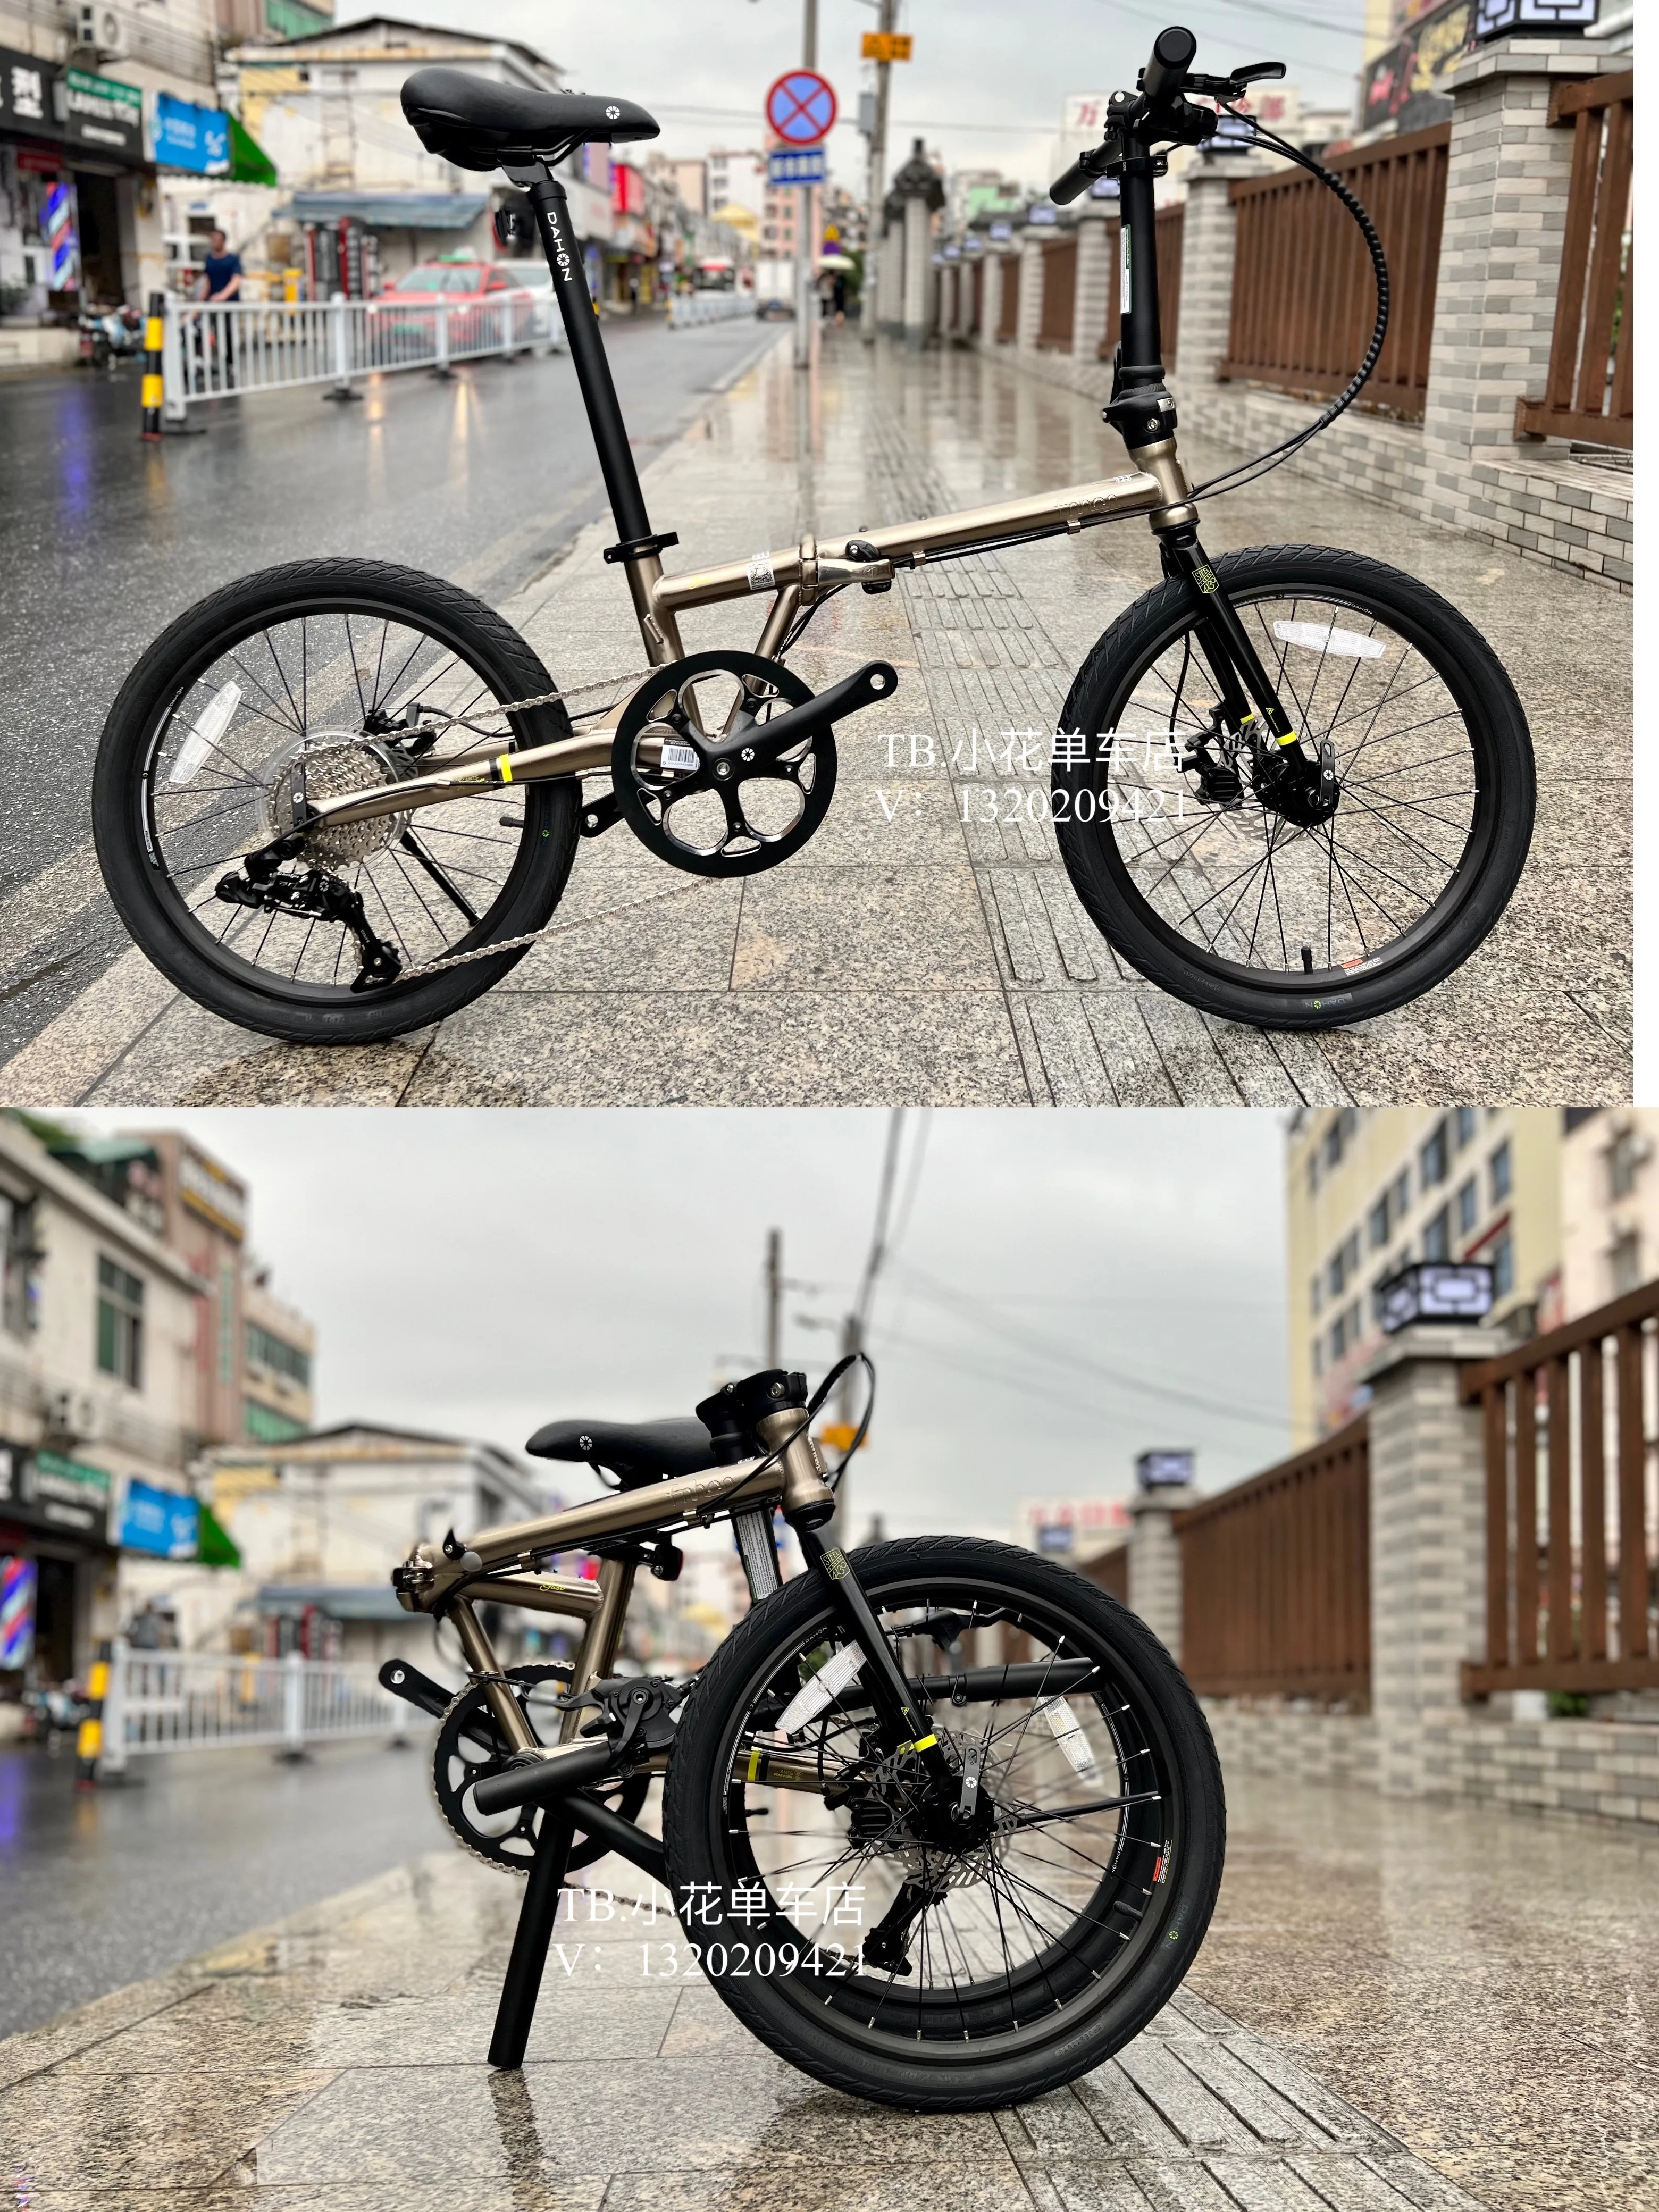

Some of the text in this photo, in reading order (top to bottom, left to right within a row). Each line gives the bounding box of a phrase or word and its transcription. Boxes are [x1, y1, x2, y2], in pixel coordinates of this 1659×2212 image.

[0, 66, 44, 119] 型
[547, 212, 573, 281] DAHON
[1194, 567, 1210, 581] STEEL
[1204, 577, 1216, 593] 4130
[1351, 604, 1373, 615] DAHON
[168, 686, 185, 707] DAHON
[1305, 998, 1346, 1009] DAHON
[823, 1551, 840, 1566] STEEL
[833, 1562, 847, 1579] 4130
[805, 1626, 827, 1643] DAHON
[1111, 1851, 1121, 1873] DAHON
[1165, 1904, 1188, 1949] DAHON
